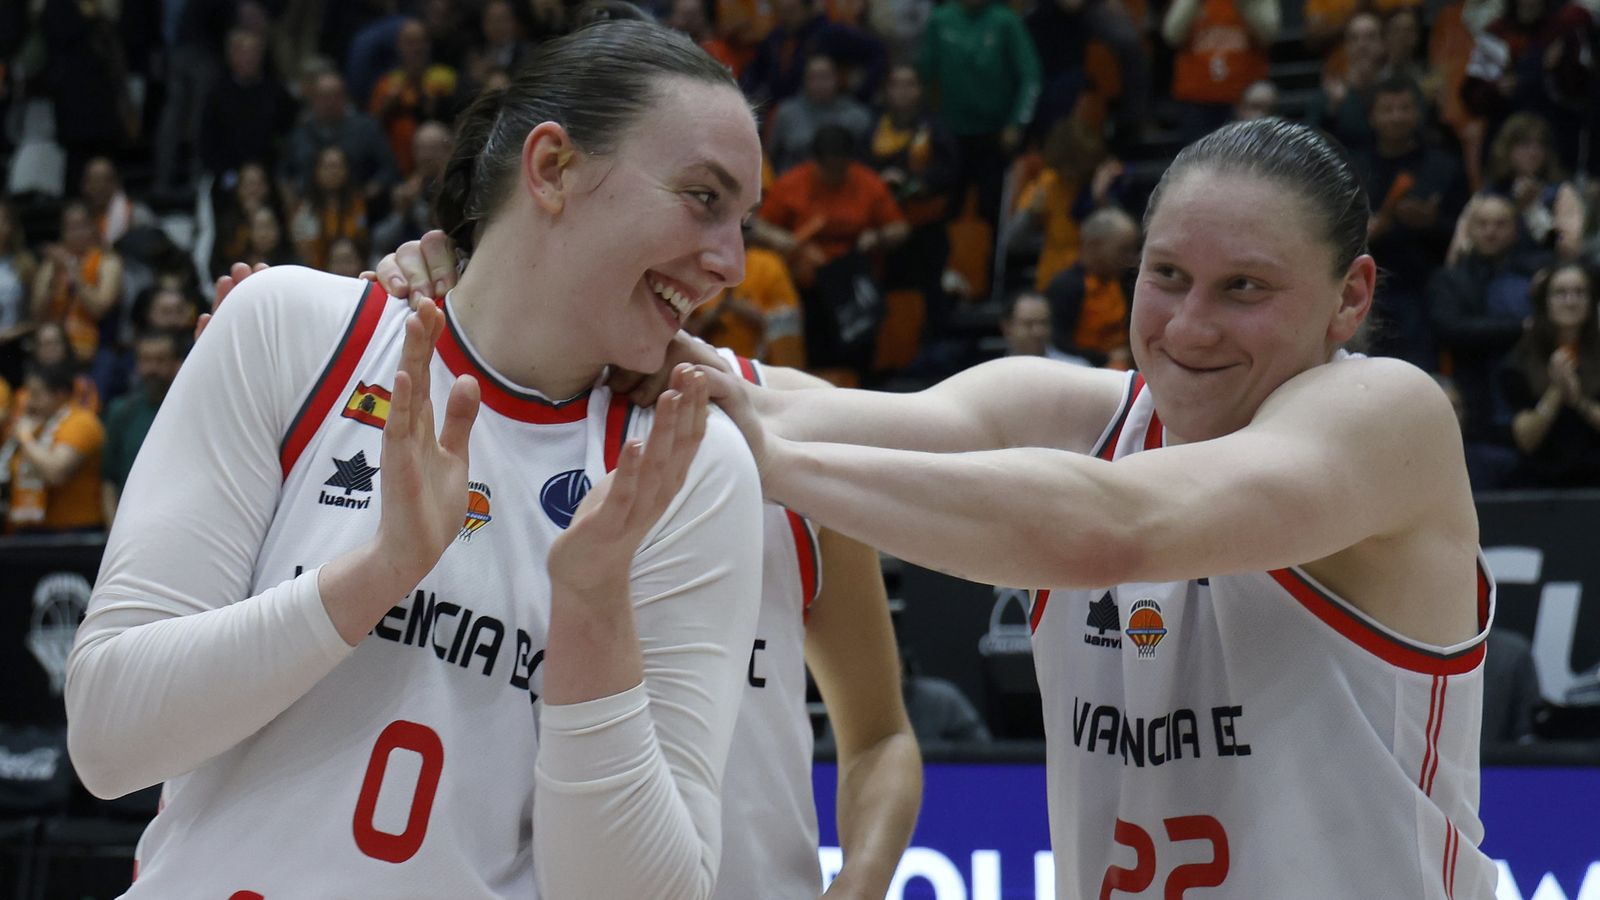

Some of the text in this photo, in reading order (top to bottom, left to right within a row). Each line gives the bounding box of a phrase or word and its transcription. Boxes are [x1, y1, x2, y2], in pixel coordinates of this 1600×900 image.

[318, 491, 371, 510] luanvi
[353, 720, 444, 864] 0
[1099, 815, 1230, 900] 22
